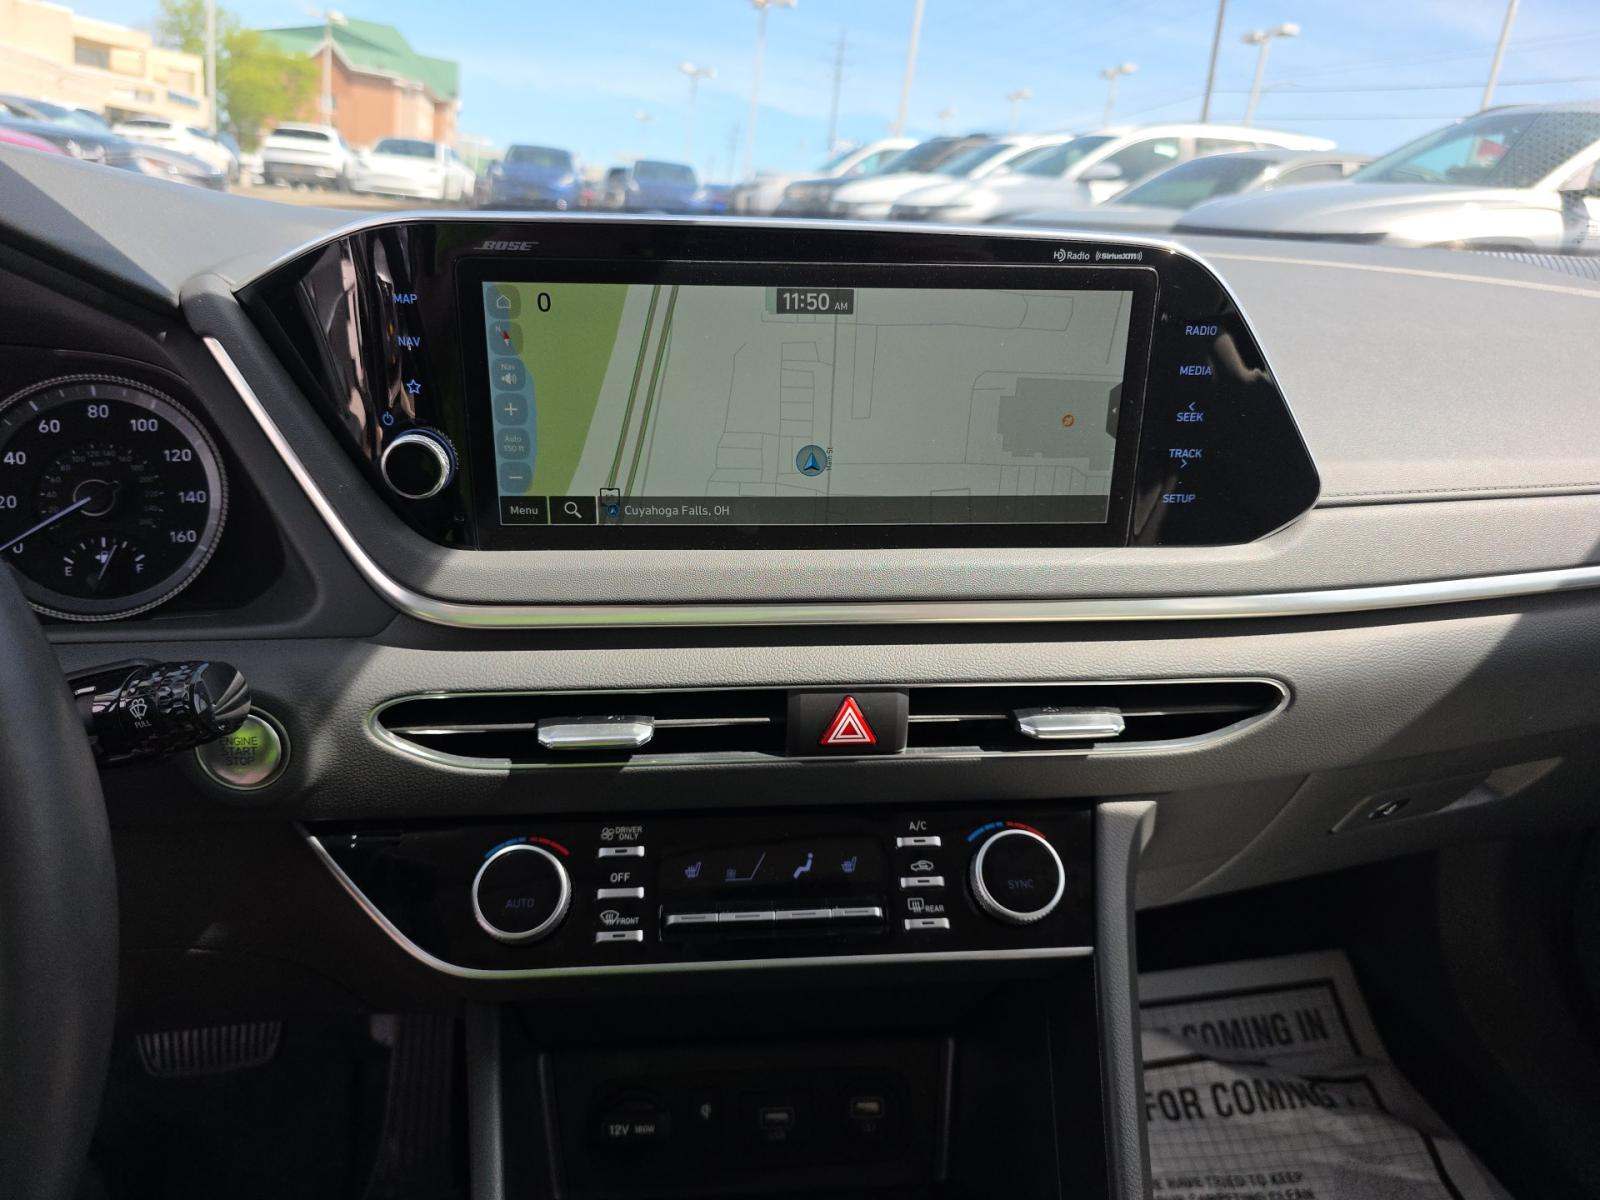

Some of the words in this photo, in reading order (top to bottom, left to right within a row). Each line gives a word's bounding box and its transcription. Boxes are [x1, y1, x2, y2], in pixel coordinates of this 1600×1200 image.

[473, 240, 539, 251] BOSE
[1067, 251, 1090, 260] Radio
[392, 294, 418, 304] MAP
[536, 292, 552, 312] 0
[783, 292, 830, 311] 11:50
[834, 302, 848, 311] AM
[1185, 325, 1218, 336] RADIO
[398, 336, 421, 347] NAV
[1180, 365, 1213, 376] MEDIA
[87, 404, 109, 419] 80
[1176, 412, 1204, 422] SEEK
[38, 419, 61, 434] 60
[130, 419, 158, 432] 100
[4, 451, 27, 465] 40
[164, 449, 192, 462] 120
[1169, 448, 1203, 459] TRACK
[178, 490, 207, 504] 140
[1162, 493, 1196, 504] SETUP
[510, 505, 539, 516] Menu
[624, 505, 679, 518] Cuyahoga
[682, 505, 711, 517] Falls,
[713, 506, 730, 516] OH
[170, 530, 197, 543] 160
[65, 566, 73, 577] E
[135, 563, 144, 574] F
[615, 825, 643, 834] DRIVER
[909, 821, 927, 831] A/C
[618, 833, 640, 841] ONLY
[609, 872, 631, 883] OFF
[1007, 879, 1034, 889] SYNC
[505, 898, 535, 909] AUTO
[924, 904, 945, 912] REAR
[616, 916, 640, 926] FRONT
[1294, 1008, 1330, 1041] IN
[1144, 1086, 1205, 1122] FOR
[610, 1124, 630, 1136] 12V
